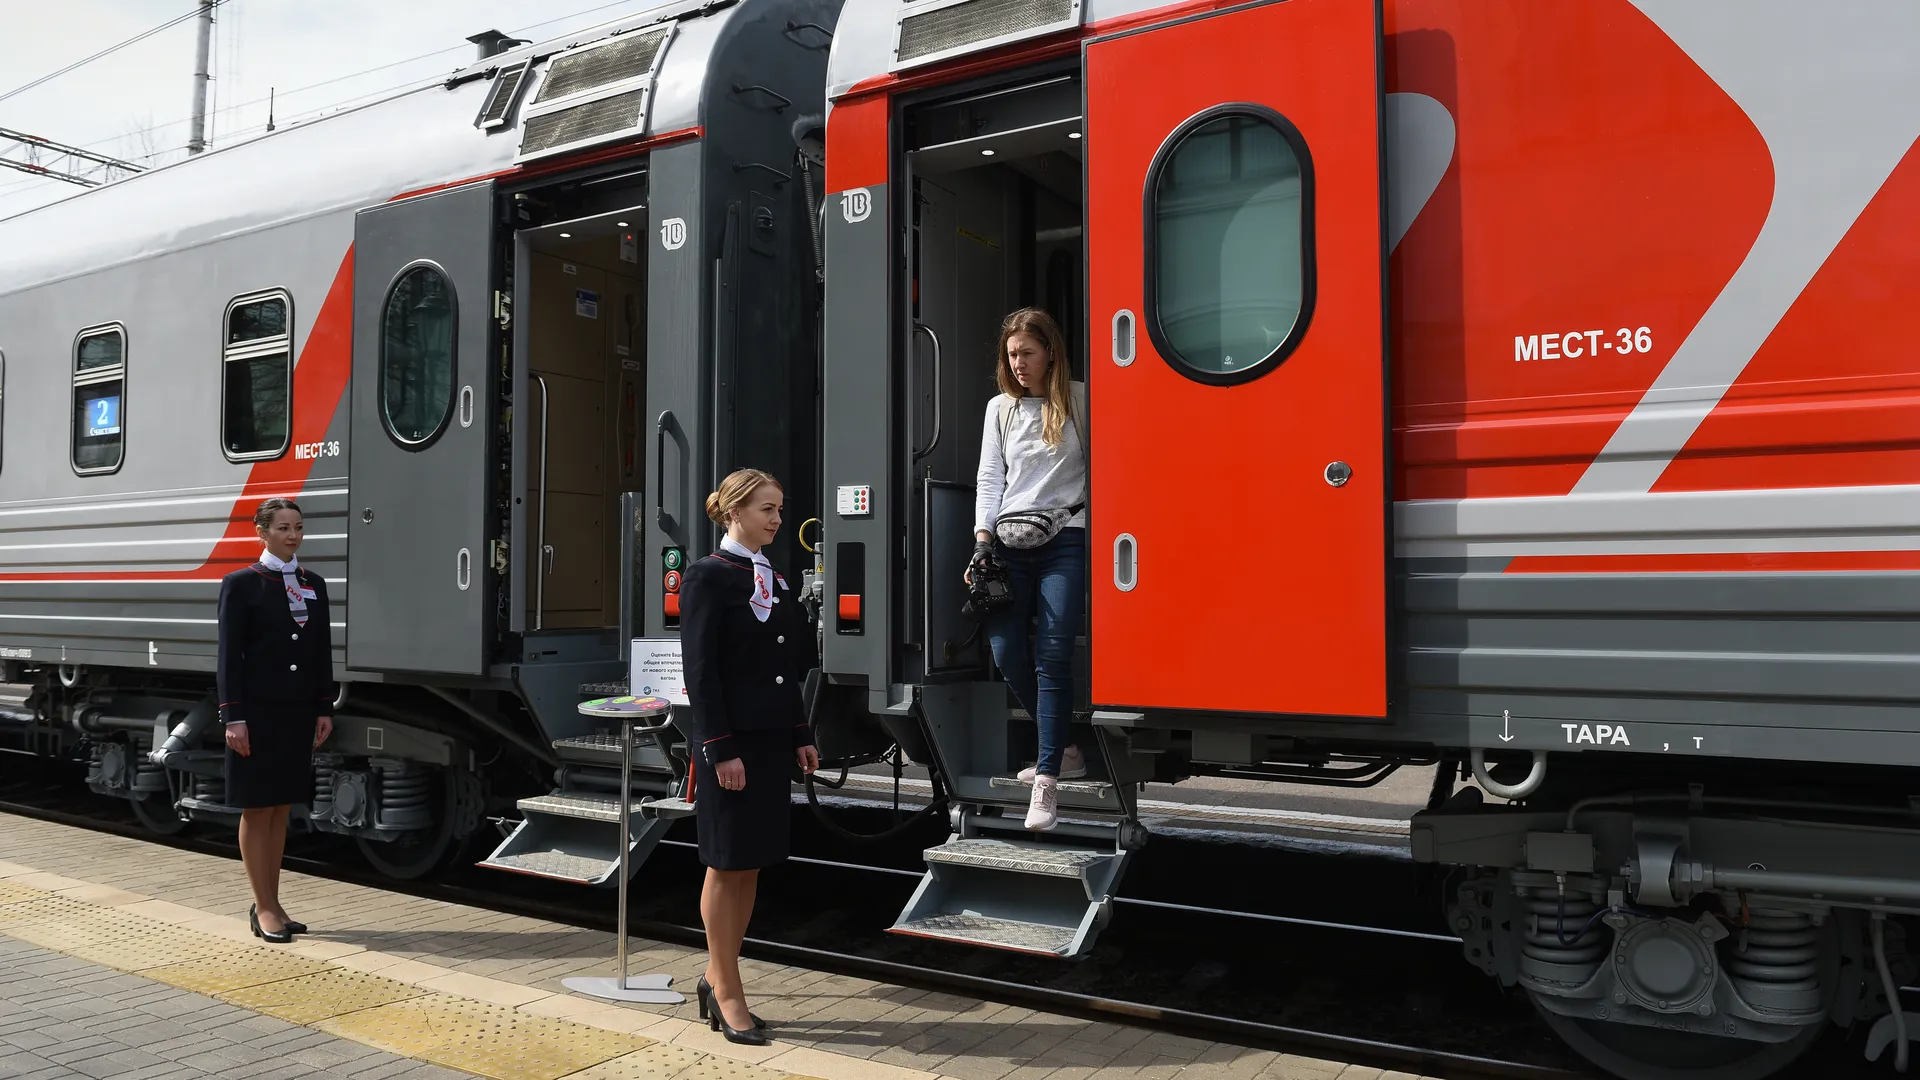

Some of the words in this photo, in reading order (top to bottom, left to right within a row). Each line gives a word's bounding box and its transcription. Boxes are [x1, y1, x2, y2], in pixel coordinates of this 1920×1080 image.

[1514, 326, 1653, 362] МЕСТ-36
[97, 400, 109, 425] 2
[295, 440, 340, 460] МЕСТ-36
[1561, 723, 1630, 746] ТАРА
